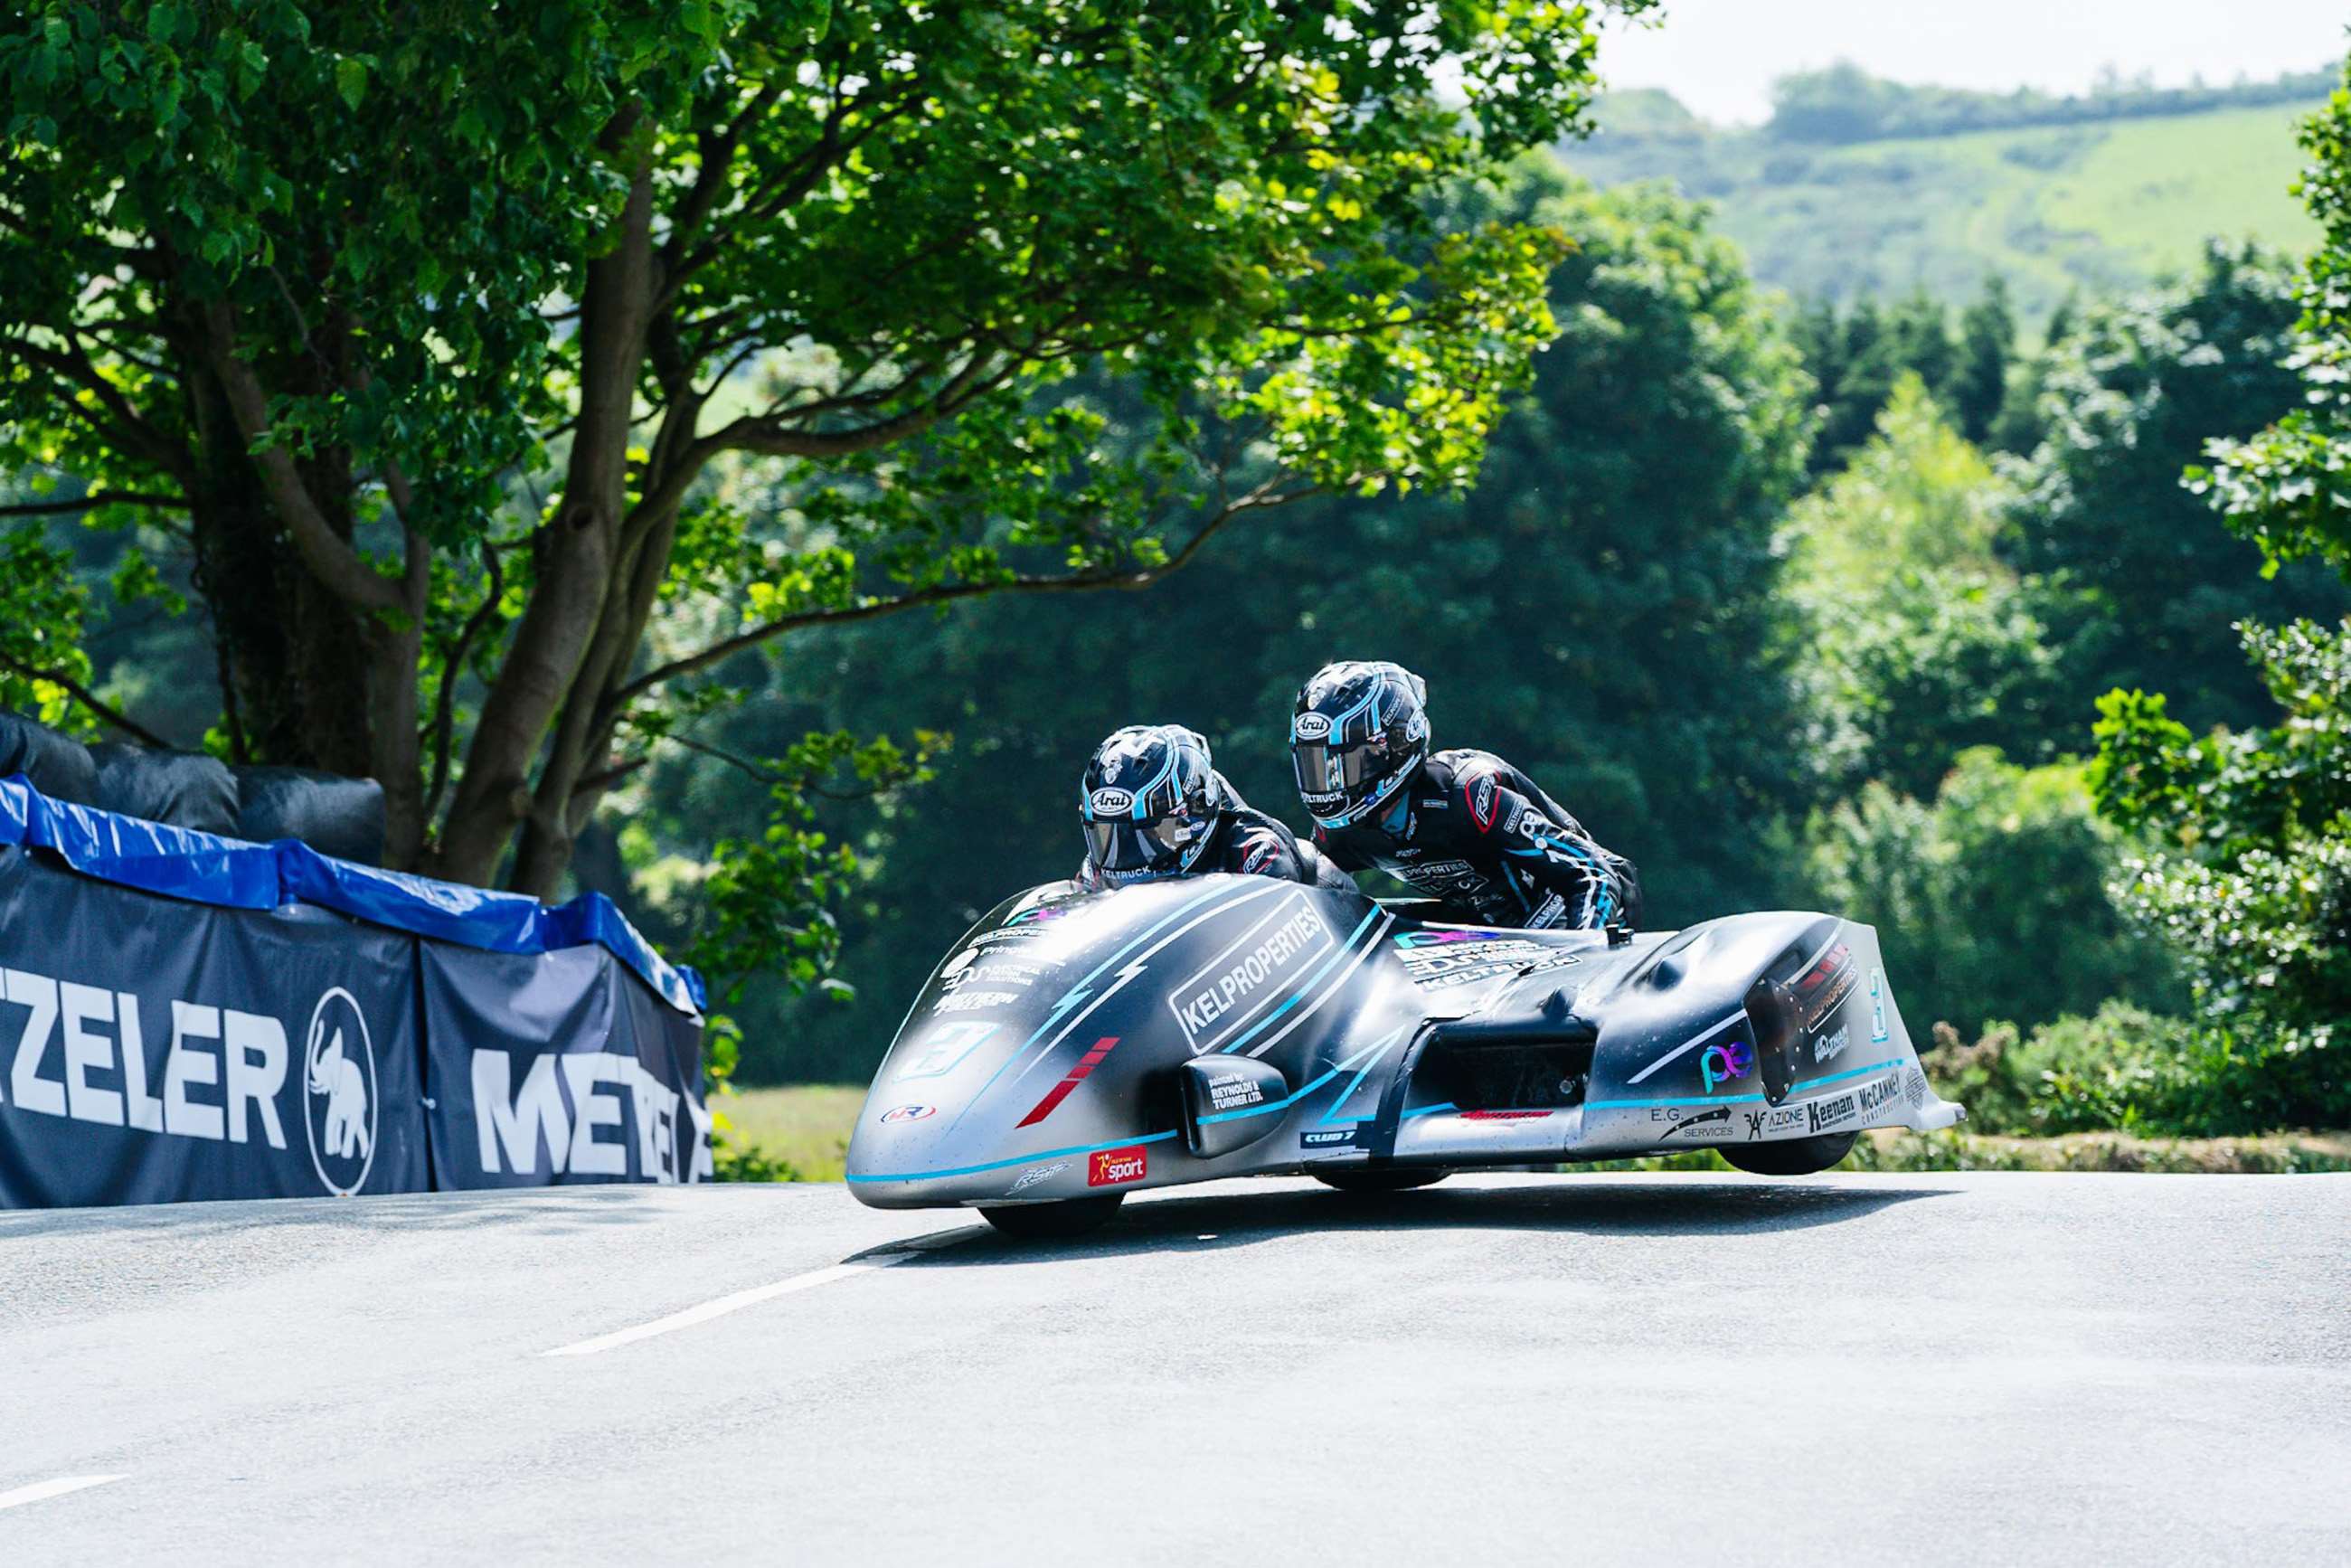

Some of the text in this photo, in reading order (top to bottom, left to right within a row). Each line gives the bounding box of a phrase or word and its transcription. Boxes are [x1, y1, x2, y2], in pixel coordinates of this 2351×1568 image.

[1300, 717, 1324, 730] Arai
[1096, 792, 1128, 806] Arai
[1100, 864, 1151, 881] KELTRUCK
[1181, 905, 1323, 1034] KELPROPERTIES
[0, 967, 288, 1150] ZELER
[1211, 1082, 1251, 1099] REYNOLDS
[1213, 1094, 1247, 1110] TURNER
[1651, 1108, 1684, 1121] E.G.
[1808, 1094, 1855, 1133] Keenan
[1684, 1127, 1733, 1138] SERVICES
[1108, 1157, 1143, 1182] sport
